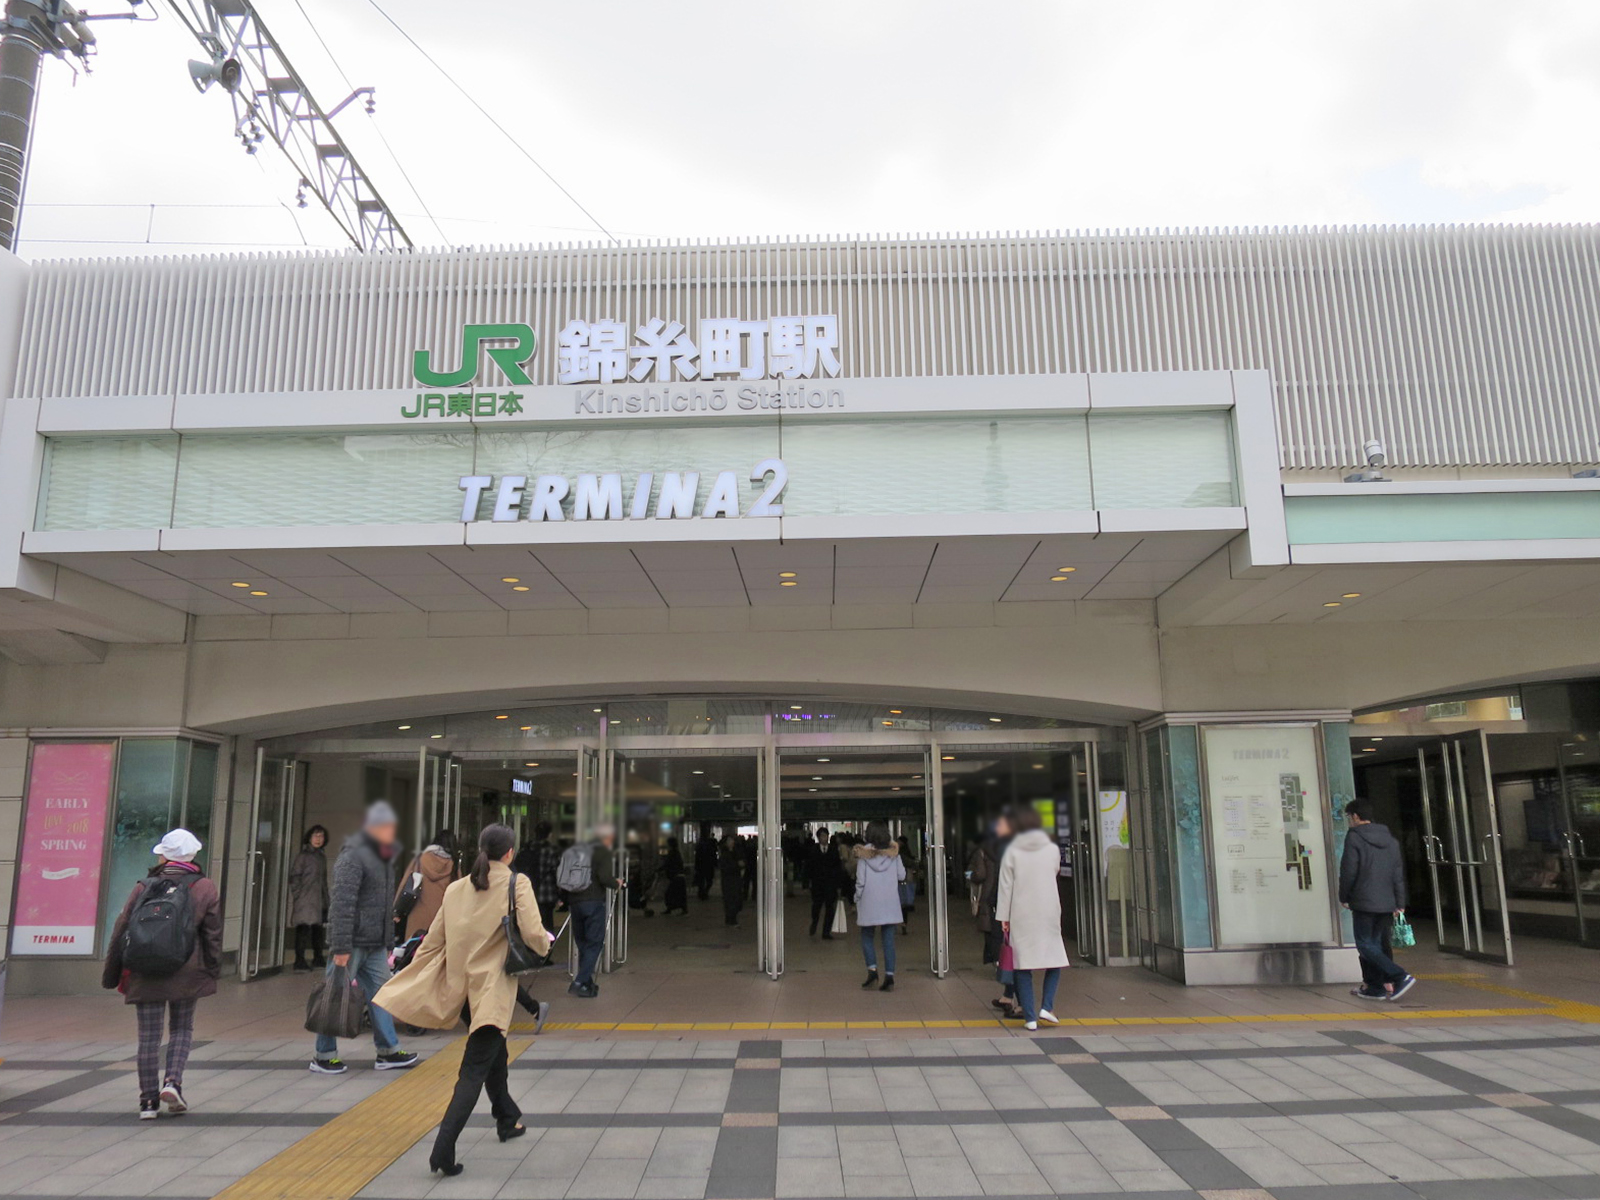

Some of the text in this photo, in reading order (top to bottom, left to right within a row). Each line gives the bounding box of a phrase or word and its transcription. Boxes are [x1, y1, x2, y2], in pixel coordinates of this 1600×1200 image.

[413, 322, 537, 387] JR
[558, 313, 842, 385] 錦糸町駅
[400, 390, 524, 418] JR東日本
[574, 384, 845, 414] Kinshichō Station
[45, 798, 90, 809] EARLY
[66, 818, 90, 834] 2018
[40, 838, 87, 851] SPRING
[33, 935, 75, 944] TERMINA
